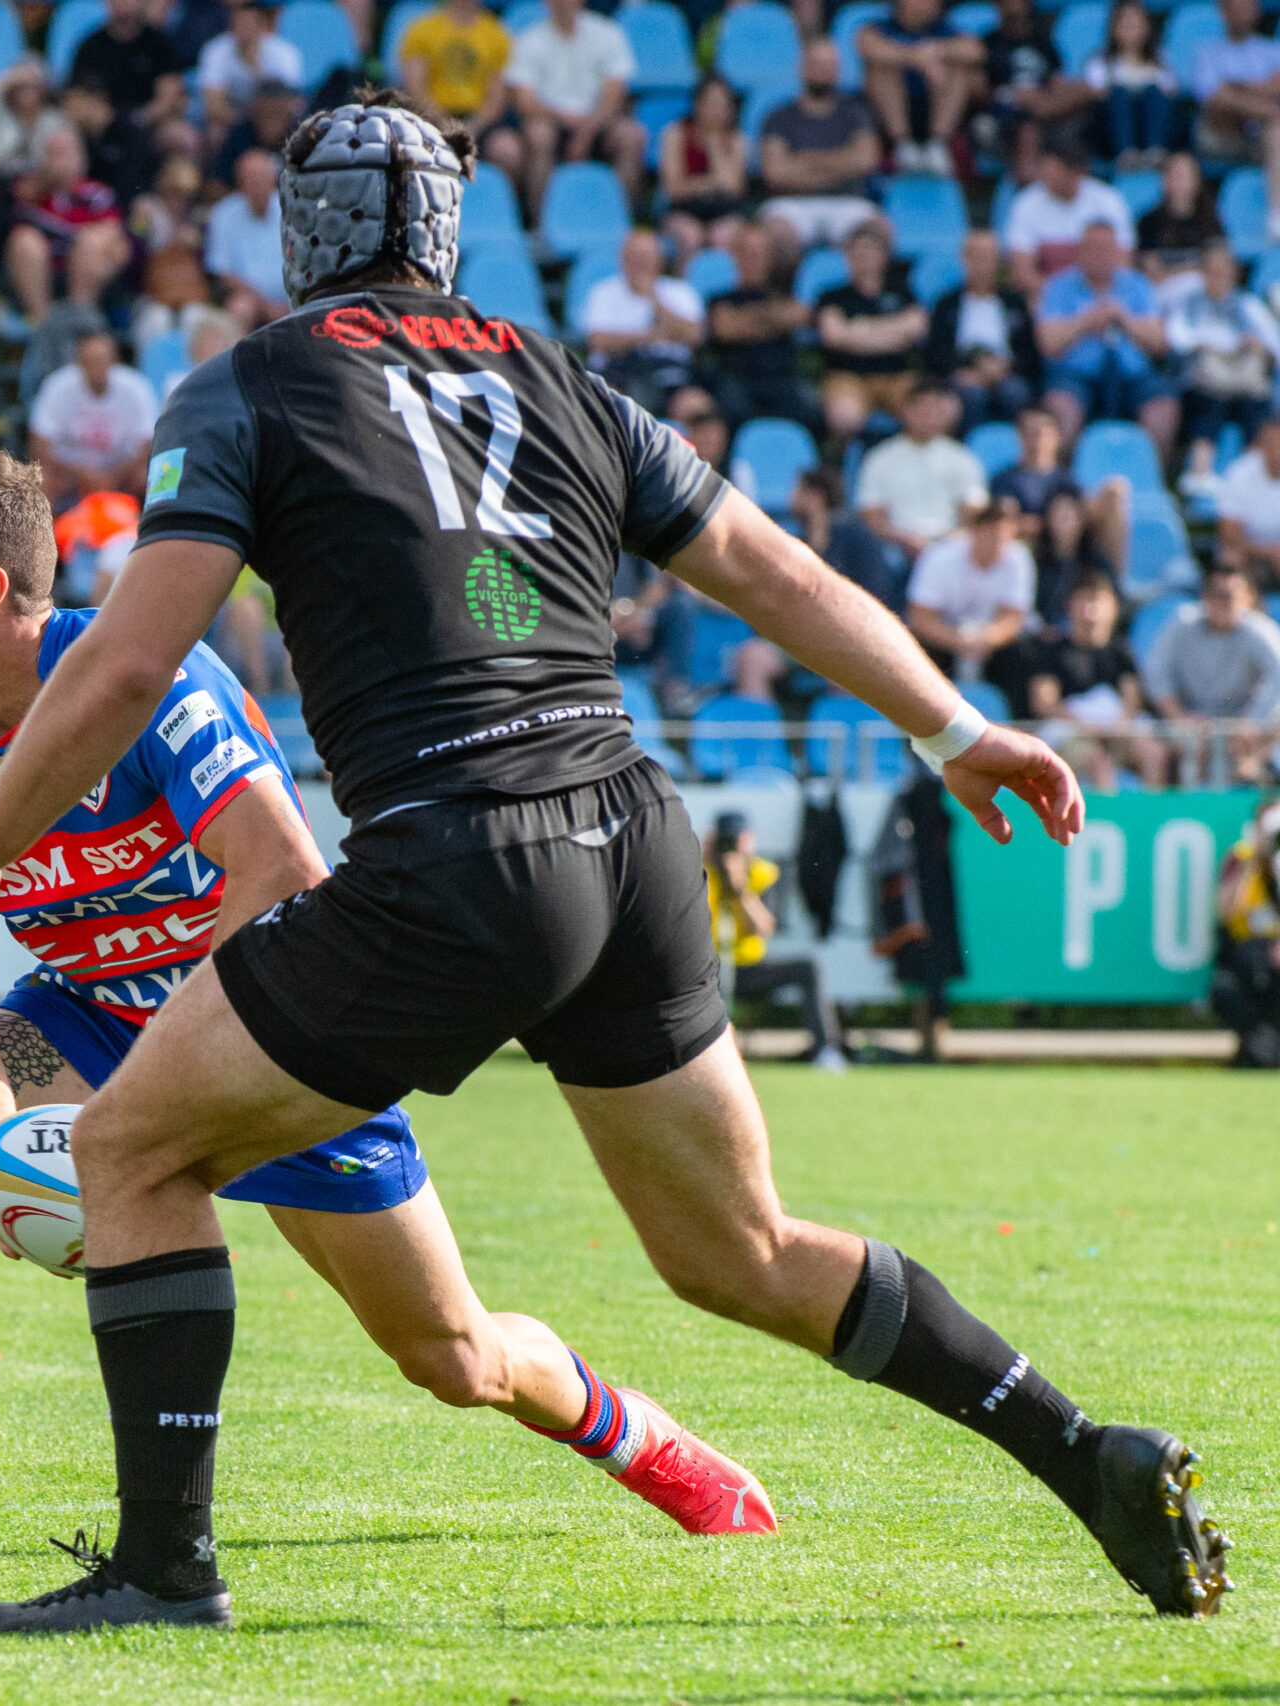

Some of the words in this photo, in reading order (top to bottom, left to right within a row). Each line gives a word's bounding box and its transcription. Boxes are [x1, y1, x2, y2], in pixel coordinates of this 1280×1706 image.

[383, 364, 553, 539] 12
[477, 589, 528, 604] VICTOR
[81, 820, 167, 876] SET
